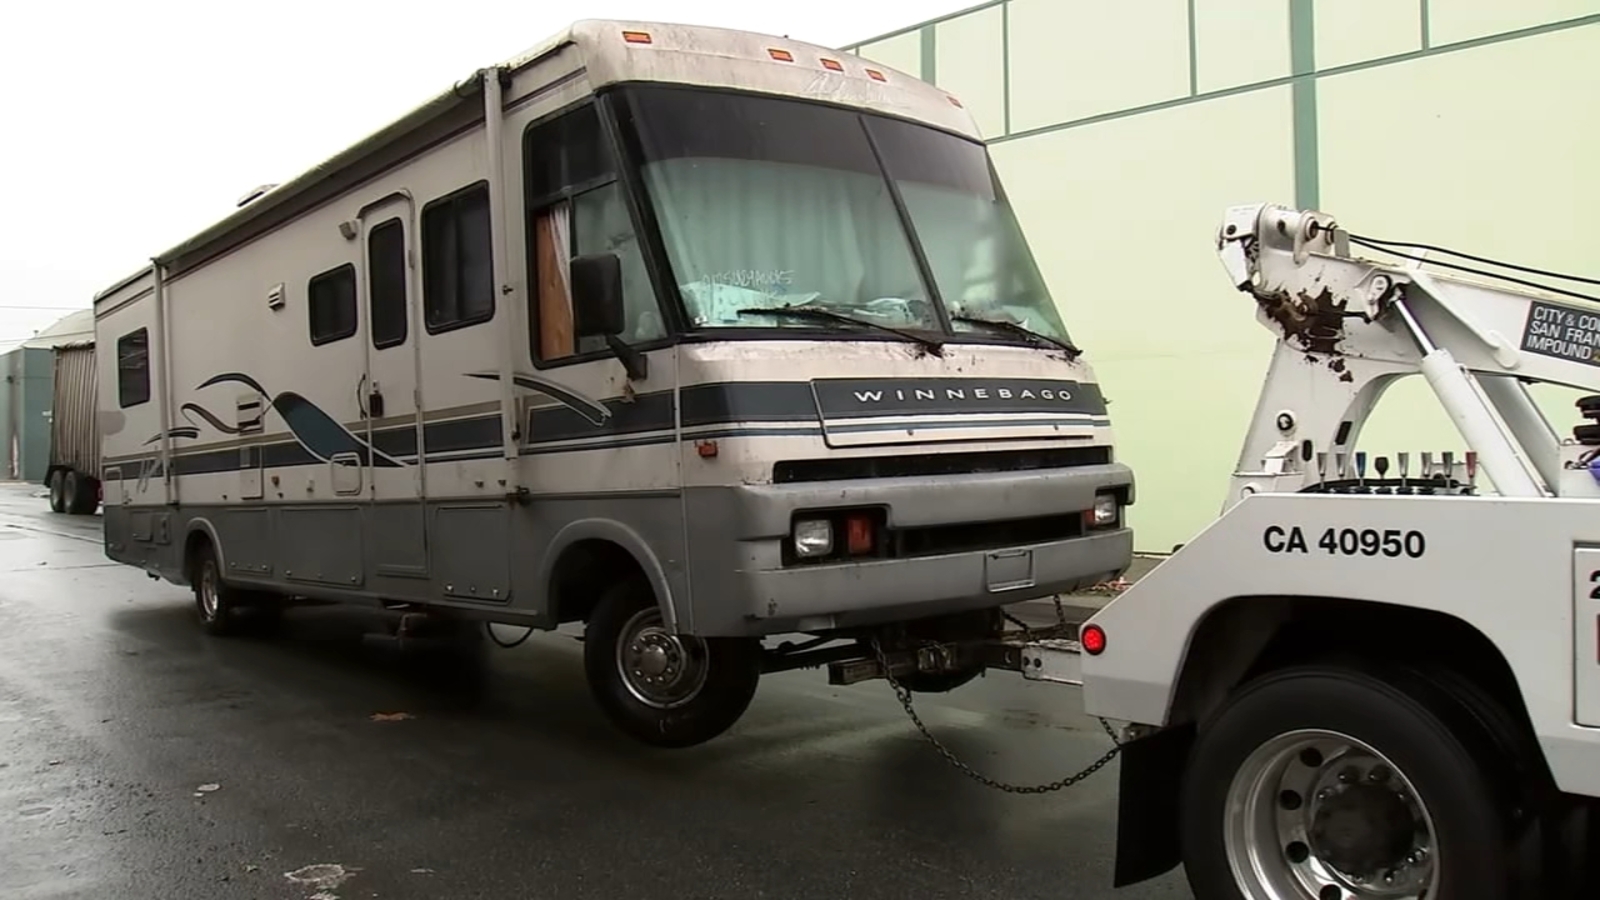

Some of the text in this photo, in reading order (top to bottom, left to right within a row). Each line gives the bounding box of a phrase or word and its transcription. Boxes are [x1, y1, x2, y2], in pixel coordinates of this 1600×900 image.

[1533, 305, 1566, 324] CITY
[1564, 314, 1575, 327] &
[1530, 320, 1561, 338] SAN
[1526, 334, 1592, 360] IMPOUND
[854, 388, 1072, 402] WINNEBAGO
[1263, 525, 1426, 559] CA 40950
